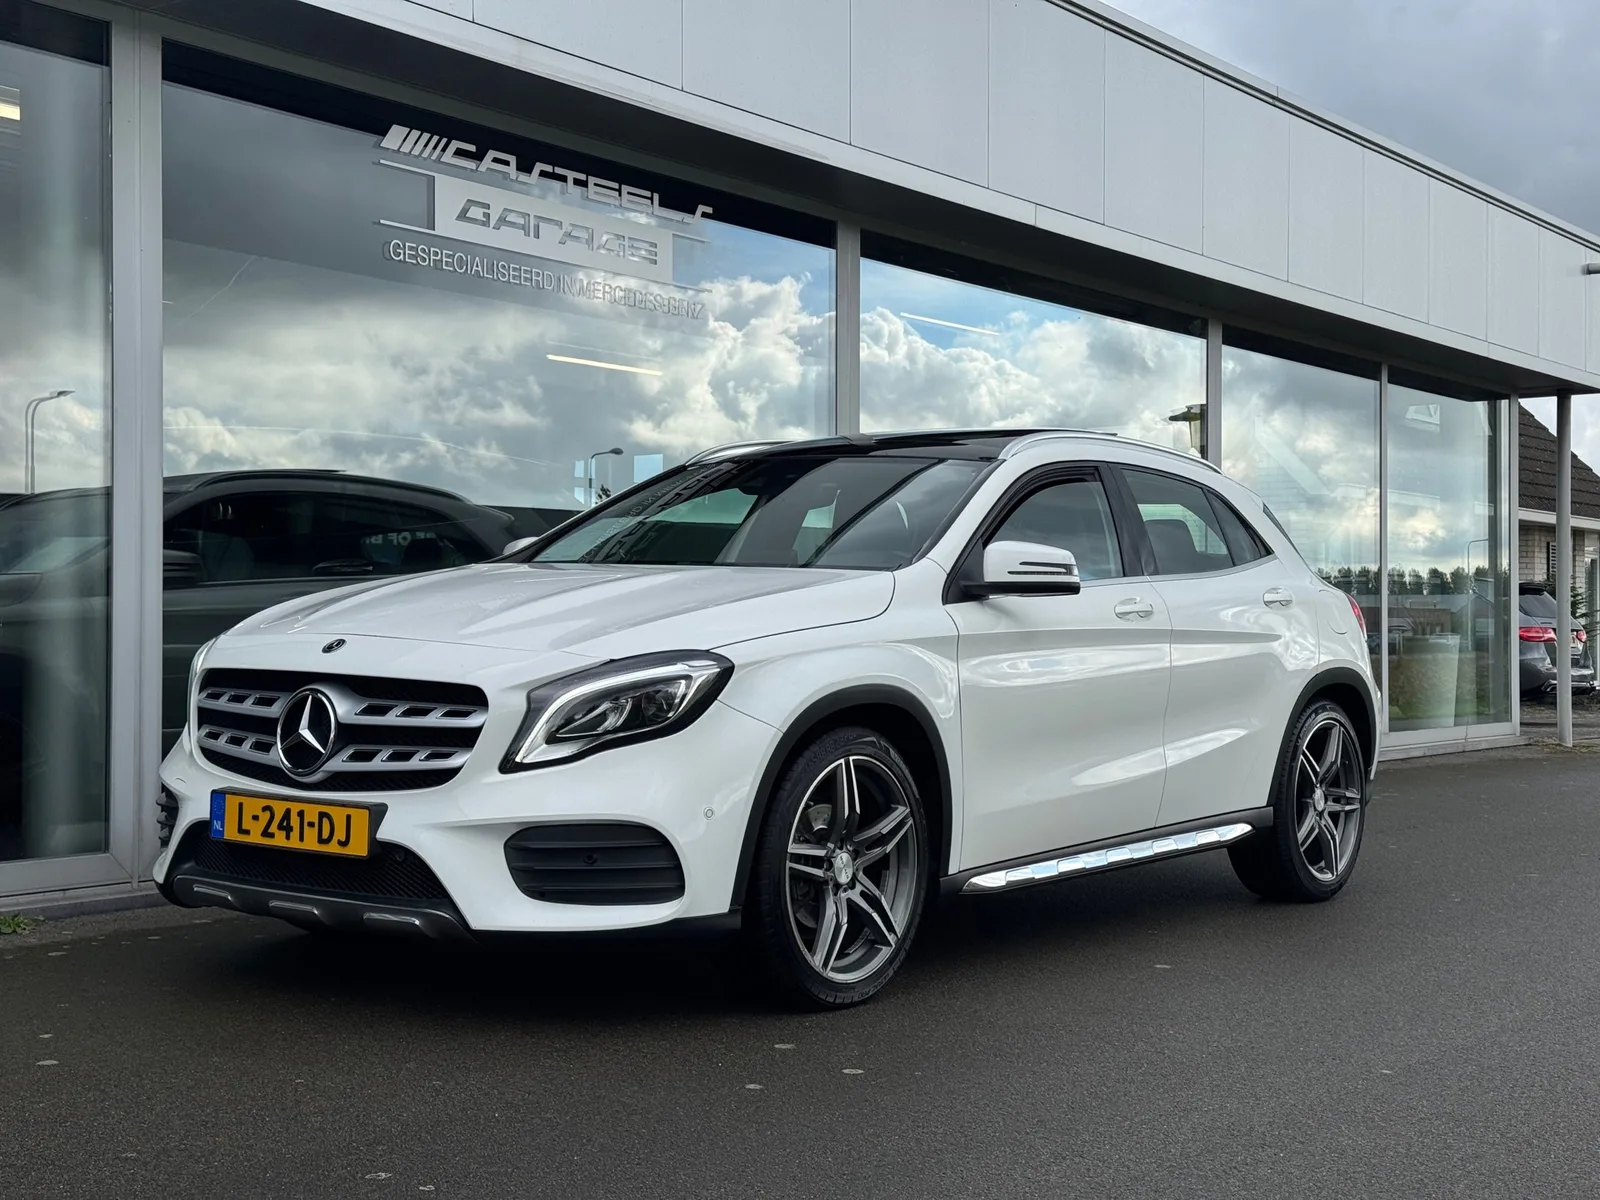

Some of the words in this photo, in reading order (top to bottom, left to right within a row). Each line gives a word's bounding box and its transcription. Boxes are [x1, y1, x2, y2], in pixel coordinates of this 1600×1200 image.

[440, 139, 713, 223] CASTEELS
[455, 198, 658, 265] GARAGE
[388, 239, 554, 290] GESPECIALISEERD
[559, 274, 575, 296] IN
[213, 820, 223, 831] NL
[237, 801, 352, 848] L-241-DJ
